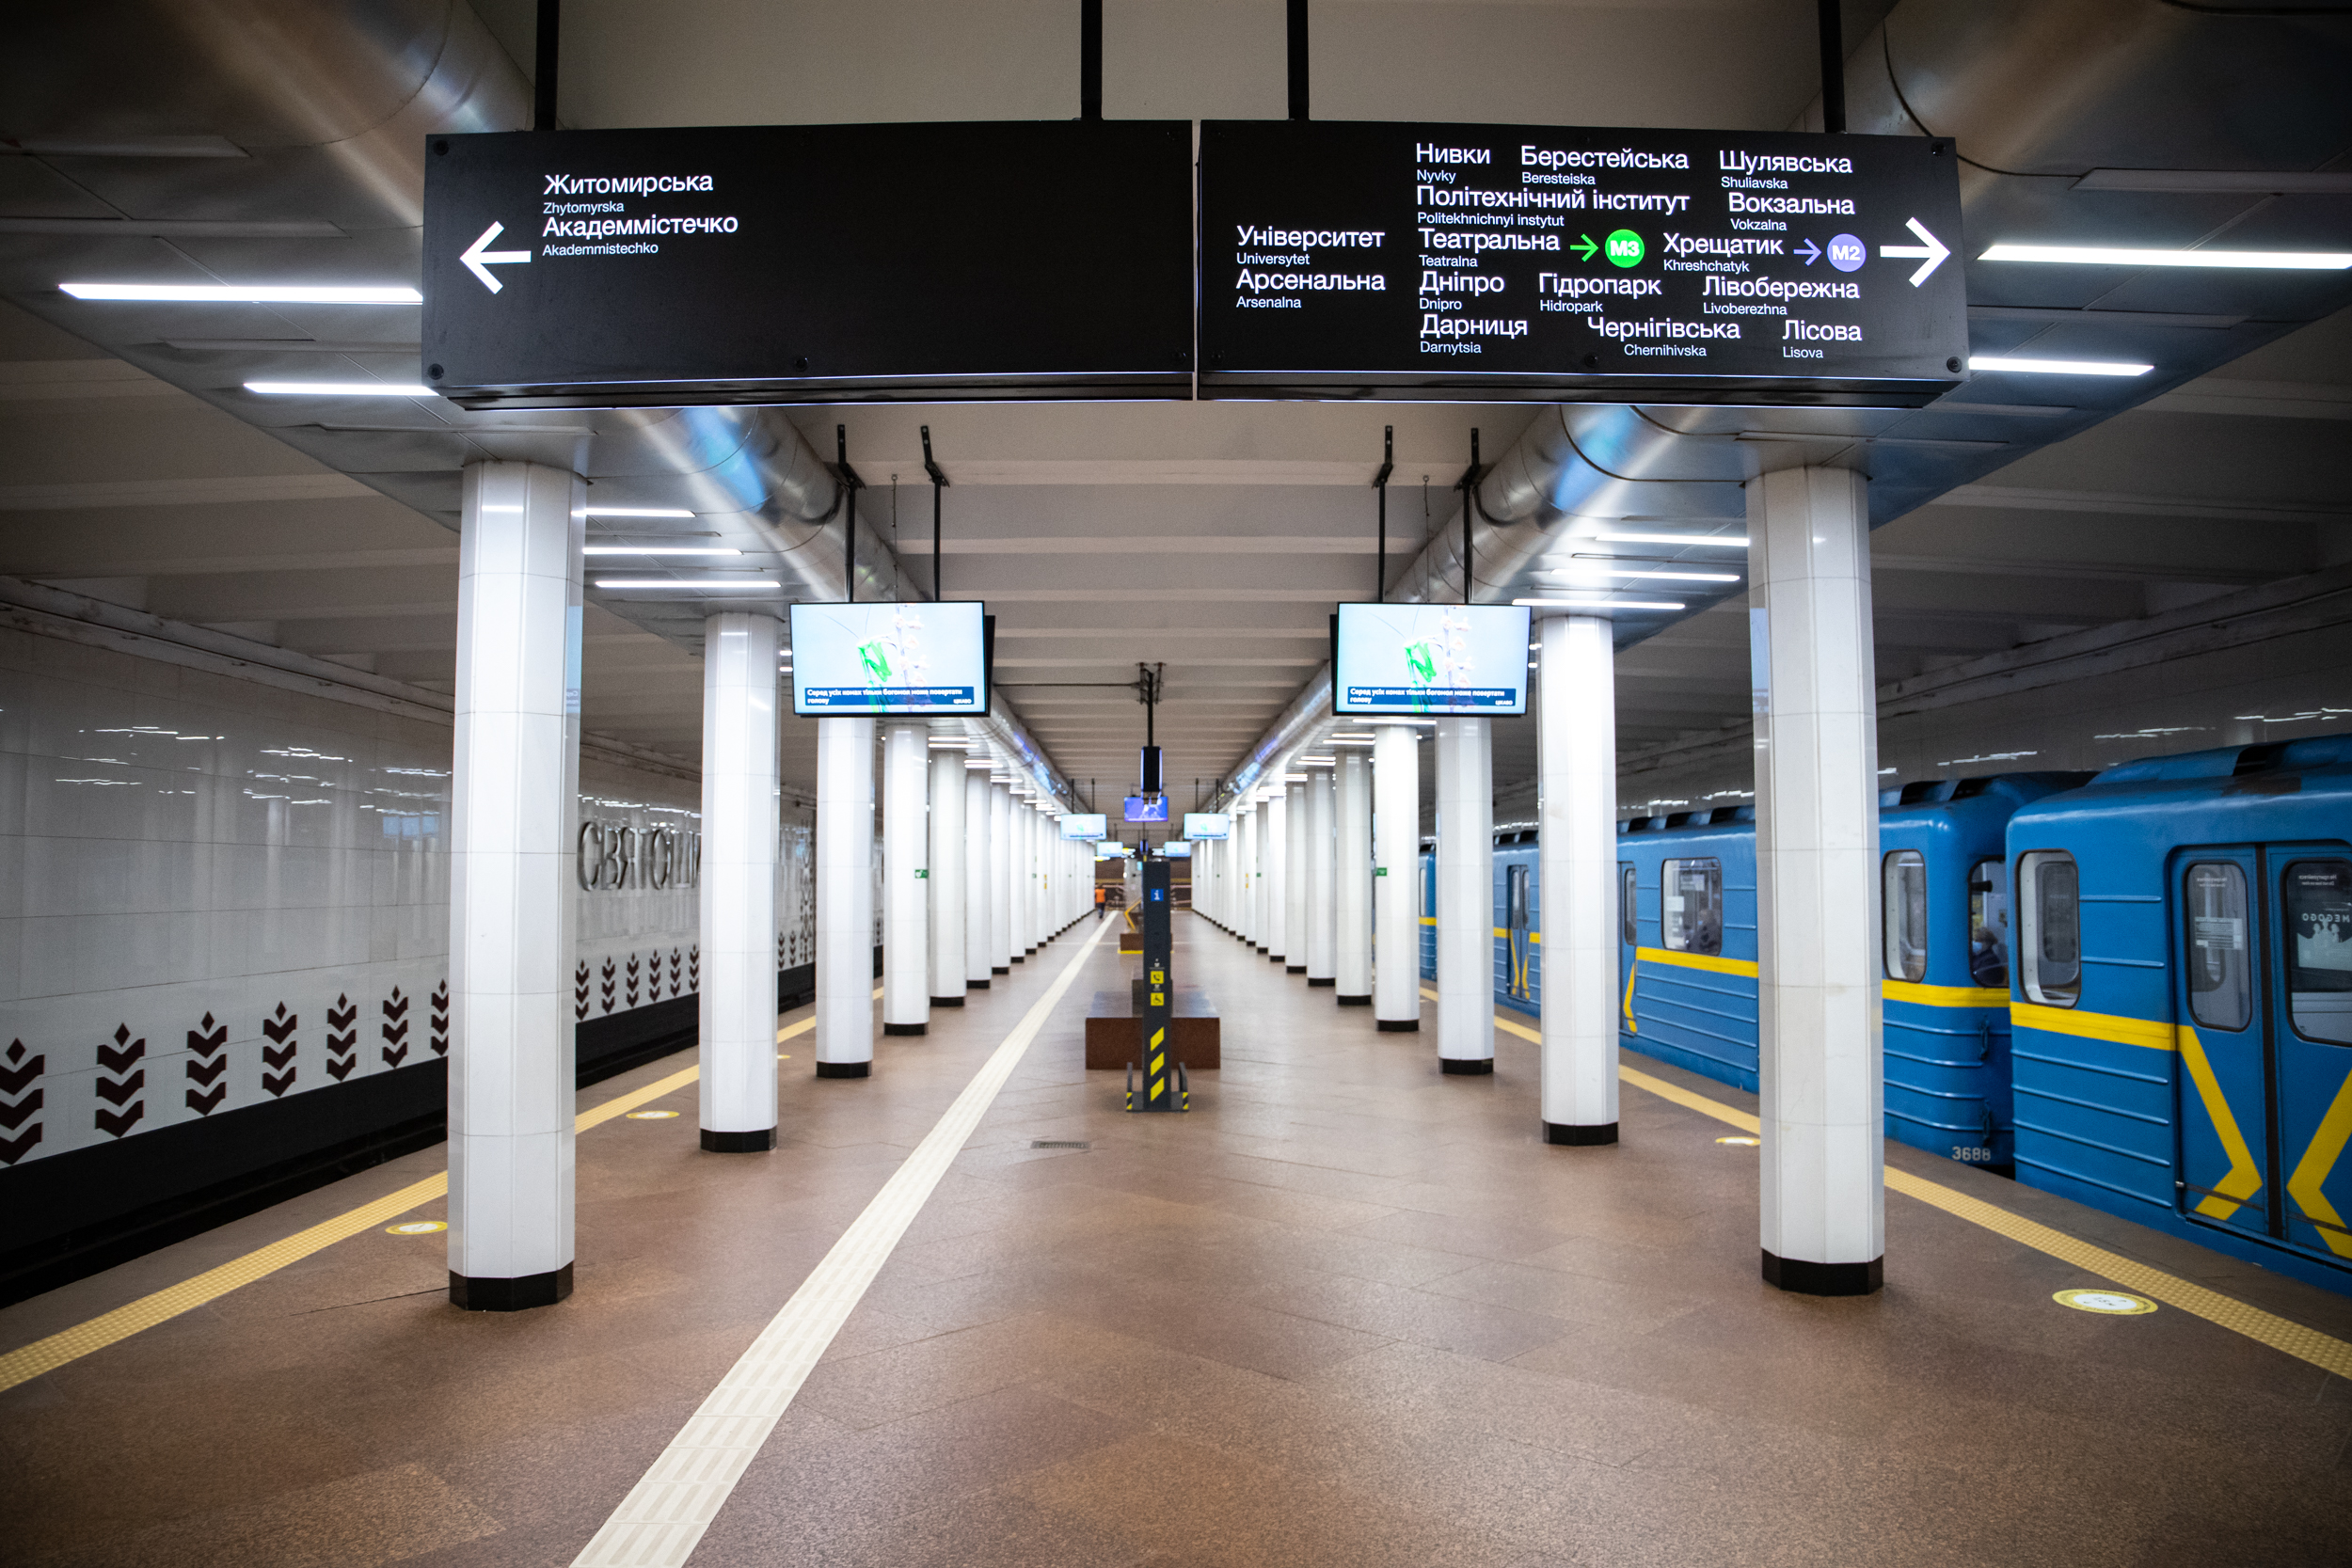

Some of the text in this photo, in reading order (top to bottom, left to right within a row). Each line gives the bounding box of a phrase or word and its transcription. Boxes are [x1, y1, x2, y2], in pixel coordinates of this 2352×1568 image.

[1416, 142, 1490, 164] Нивки
[1520, 145, 1690, 170] Берестейська
[1719, 150, 1853, 175] Шулявська
[543, 173, 713, 197] Житомирська
[1416, 168, 1456, 183] Nyvky
[1521, 171, 1596, 184] Beresteiska
[1721, 175, 1788, 189] Shuliavska
[542, 200, 624, 214] Zhytomyrska
[1417, 184, 1691, 215] Політехнічний інститут
[1728, 191, 1855, 214] Вокзальна
[542, 214, 738, 240] Академмістечко
[1417, 211, 1565, 228] Politekhnichnyi instytut
[1729, 217, 1788, 230] Vokzalna
[1236, 225, 1385, 251] Університет
[1419, 227, 1561, 254] Театральна
[1662, 232, 1784, 258] Хрещатик
[542, 242, 659, 256] Akademmistechko
[1236, 252, 1310, 267] Universytet
[1418, 254, 1478, 267] Teatralna
[1663, 259, 1750, 275] Khreshchatyk
[1235, 268, 1386, 294] Арсенальна
[1419, 270, 1505, 296] Дніпро
[1538, 272, 1662, 299] Гідропарк
[1702, 275, 1861, 302] Лівобережна
[1235, 295, 1301, 308] Arsenalna
[1419, 297, 1462, 312] Dnipro
[1539, 299, 1603, 314] Hidropark
[1703, 301, 1788, 315] Livoberezhna
[1420, 313, 1528, 340] Дарниця
[1587, 316, 1741, 341] Чернігівська
[1782, 319, 1863, 341] Лісова
[1420, 341, 1481, 356] Darnytsia
[1624, 343, 1707, 356] Chernihivska
[1782, 345, 1823, 358] Lisova
[577, 821, 702, 891] СВЯТОШ
[1951, 1146, 1991, 1162] 3688
